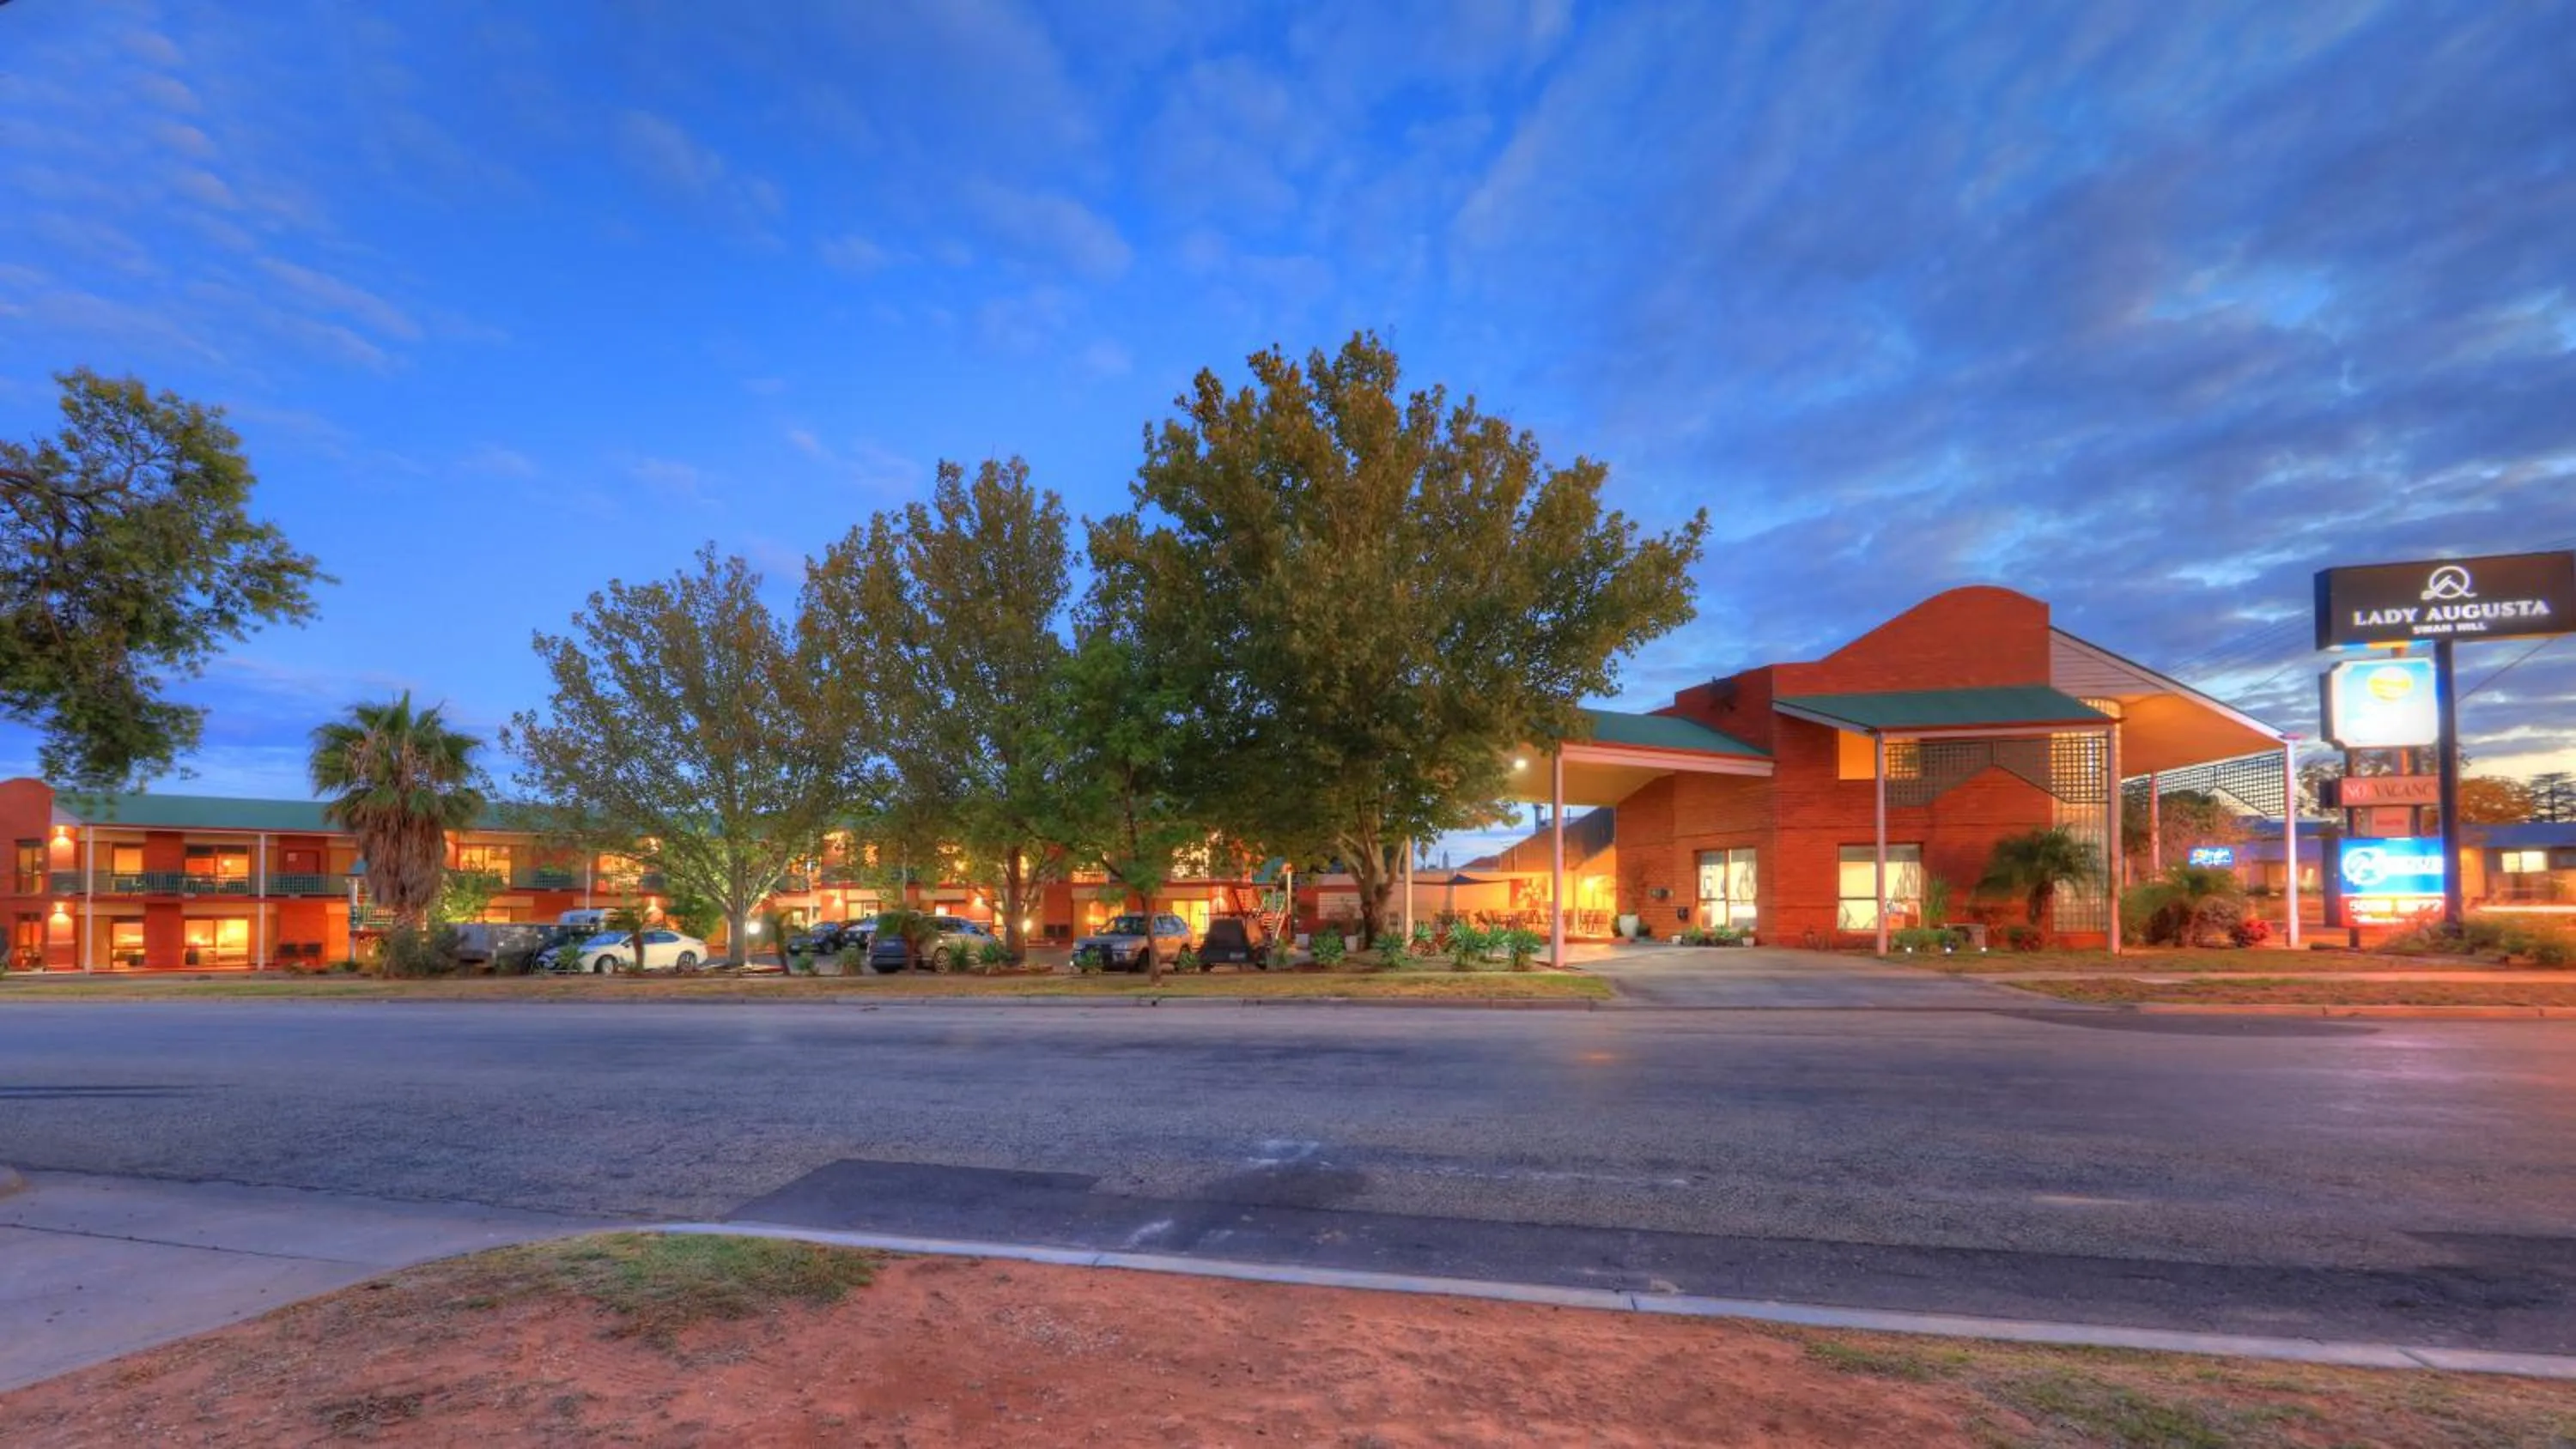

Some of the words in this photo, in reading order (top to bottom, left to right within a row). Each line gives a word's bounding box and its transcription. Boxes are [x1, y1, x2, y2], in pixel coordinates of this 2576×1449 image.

[2354, 609, 2418, 625] LADY
[2427, 601, 2549, 621] AUGUSTA
[2413, 624, 2452, 634] SWAN
[2456, 621, 2487, 632] HILL
[2371, 781, 2435, 797] VACANC
